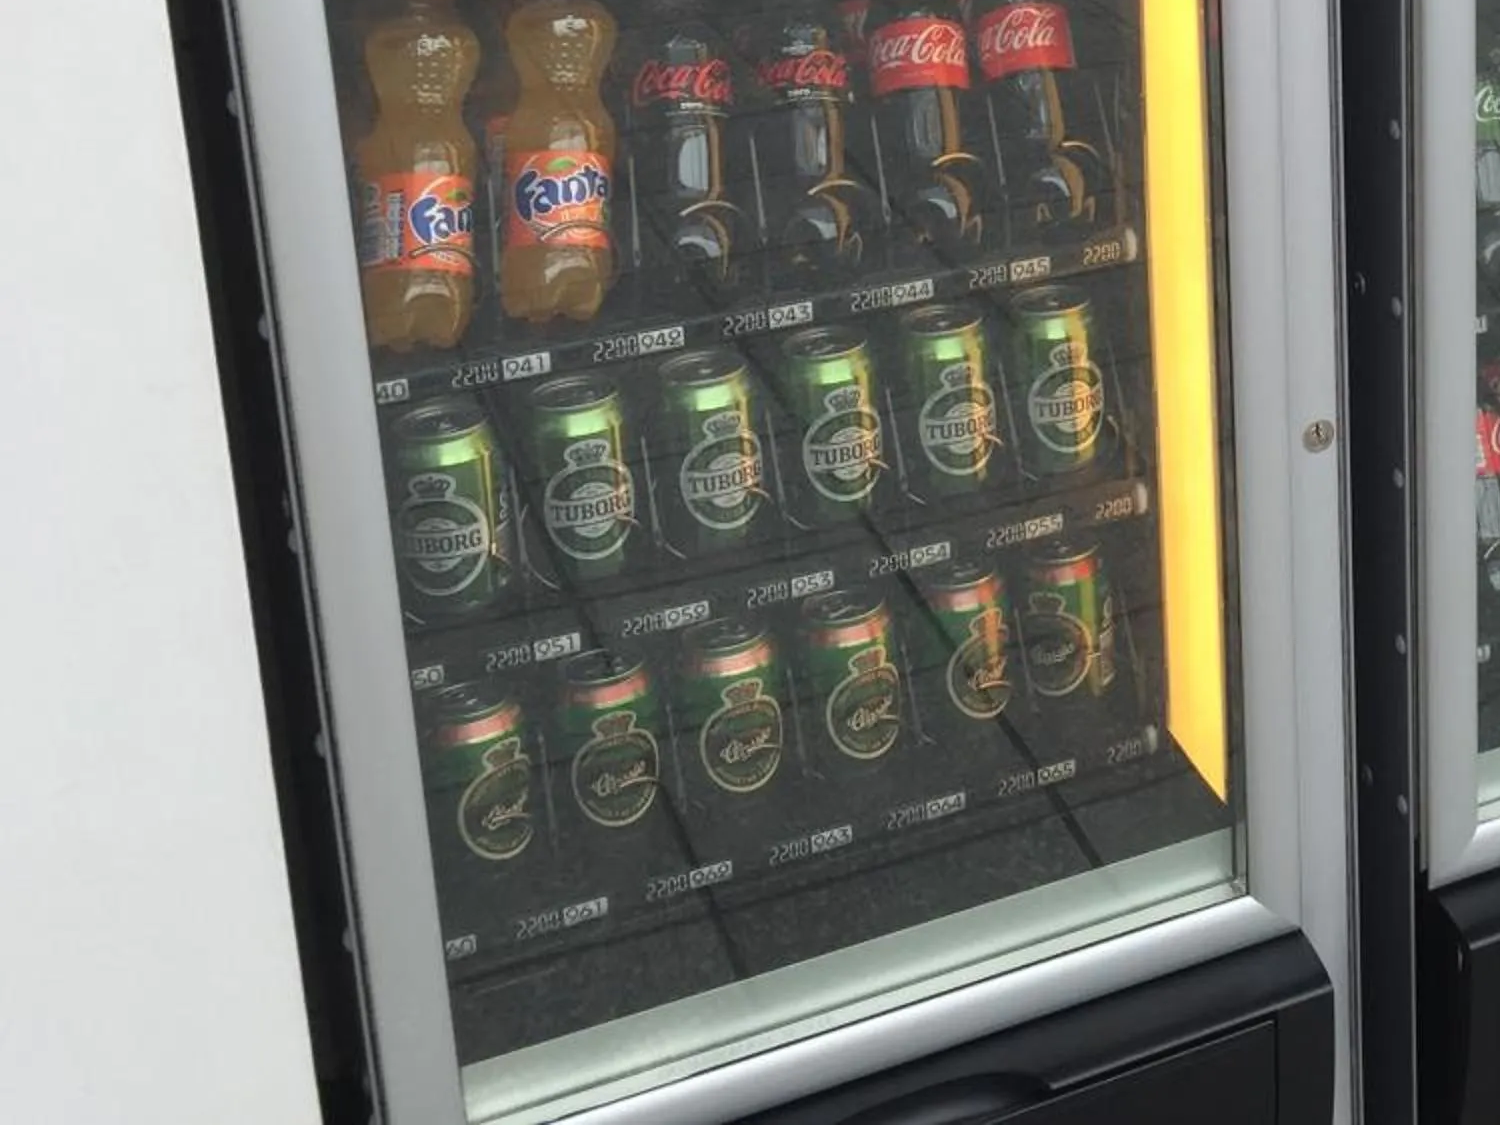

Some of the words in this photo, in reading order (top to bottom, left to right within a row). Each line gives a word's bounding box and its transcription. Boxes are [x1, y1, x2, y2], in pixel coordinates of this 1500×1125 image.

[634, 58, 733, 107] Coca-Co
[515, 163, 608, 223] Fanta
[408, 194, 475, 245] Fan
[1011, 258, 1050, 279] 945
[893, 280, 933, 303] 944
[770, 304, 812, 326] 943
[640, 328, 684, 352] 942
[504, 354, 549, 379] 941
[687, 458, 762, 495] TUBORG
[911, 547, 949, 567] 954
[792, 573, 834, 595] 953
[535, 634, 579, 659] 951
